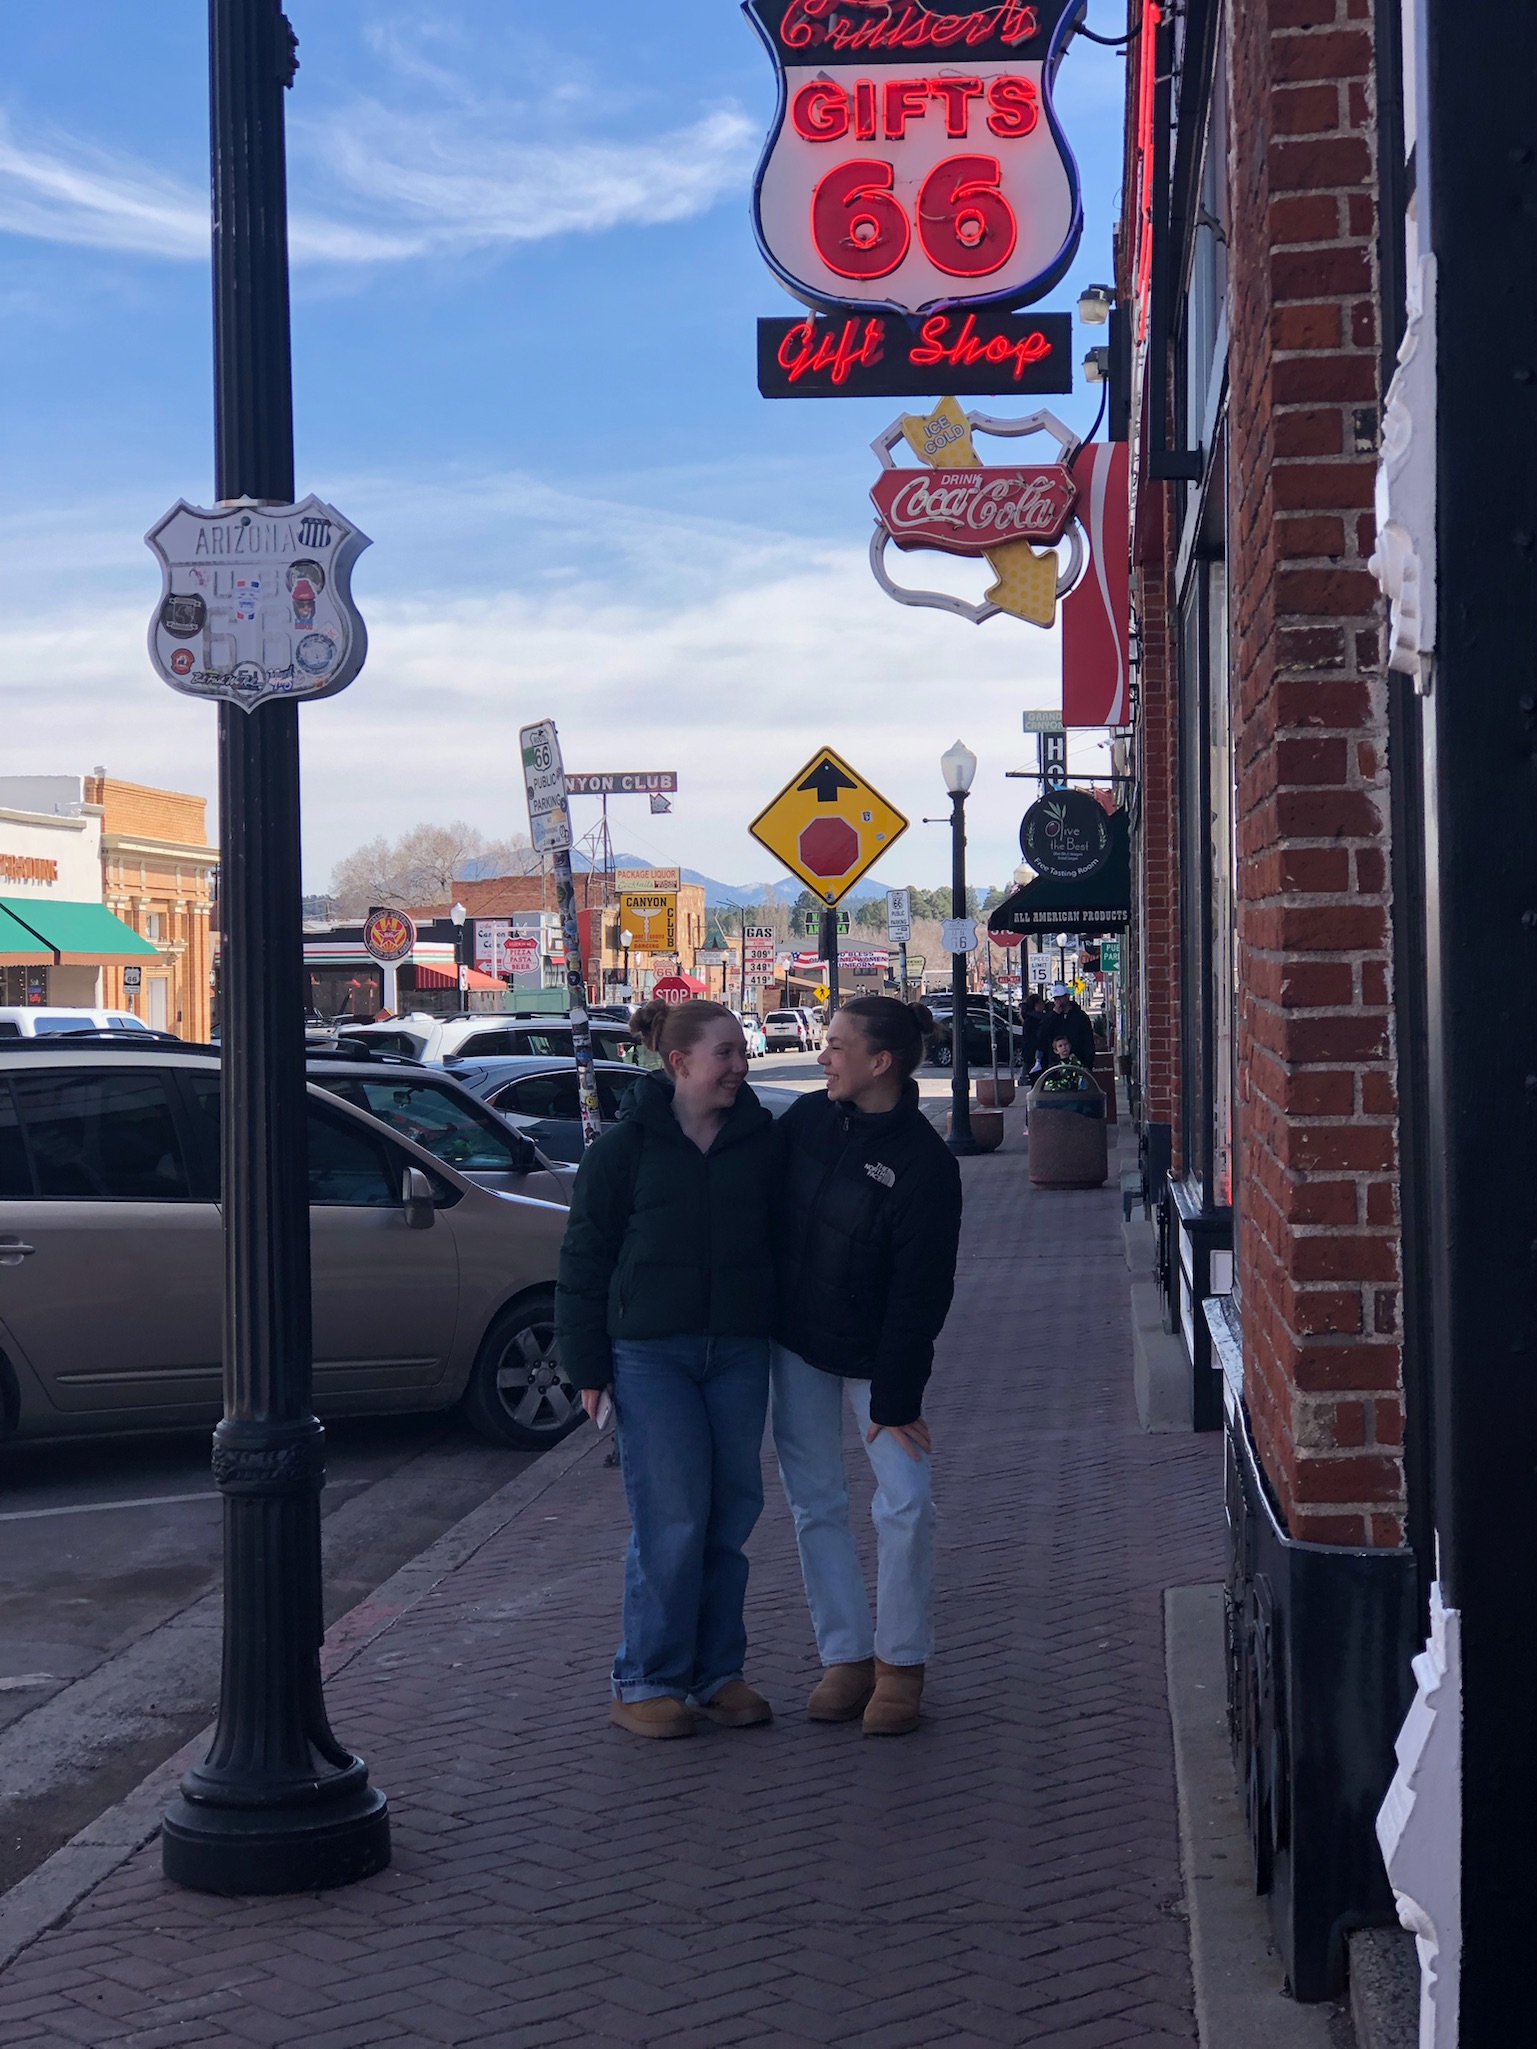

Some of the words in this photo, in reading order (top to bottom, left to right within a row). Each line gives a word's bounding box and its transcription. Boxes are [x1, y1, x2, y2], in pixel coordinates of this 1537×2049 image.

[790, 75, 1039, 141] GIFTS
[810, 153, 1018, 280] 66
[778, 317, 885, 383] Gift
[908, 313, 1052, 381] Shop
[923, 415, 951, 438] ICE
[924, 424, 965, 455] COLD
[941, 474, 982, 486] DRINK
[195, 523, 298, 556] ARIZONA
[1027, 711, 1063, 723] GRAND
[534, 745, 551, 768] 66
[533, 773, 557, 789] PUBLIC
[621, 774, 672, 789] CLUB
[533, 793, 561, 812] PARKING
[1045, 820, 1080, 841] Olive
[1050, 838, 1065, 850] the
[1066, 836, 1089, 851] Best
[617, 870, 650, 879] PACKAGE
[651, 869, 676, 878] LIQUOR
[1034, 857, 1050, 872] Free
[1050, 866, 1078, 878] Tasting
[1077, 858, 1100, 875] Room
[626, 897, 667, 907] CANYON
[1014, 912, 1031, 923] ALL
[1033, 911, 1080, 922] AMERICAN
[1082, 910, 1128, 921] PRODUCTS
[746, 927, 772, 938] GAS
[656, 968, 673, 977] 66
[1032, 969, 1047, 981] 15
[656, 988, 688, 1005] STOP
